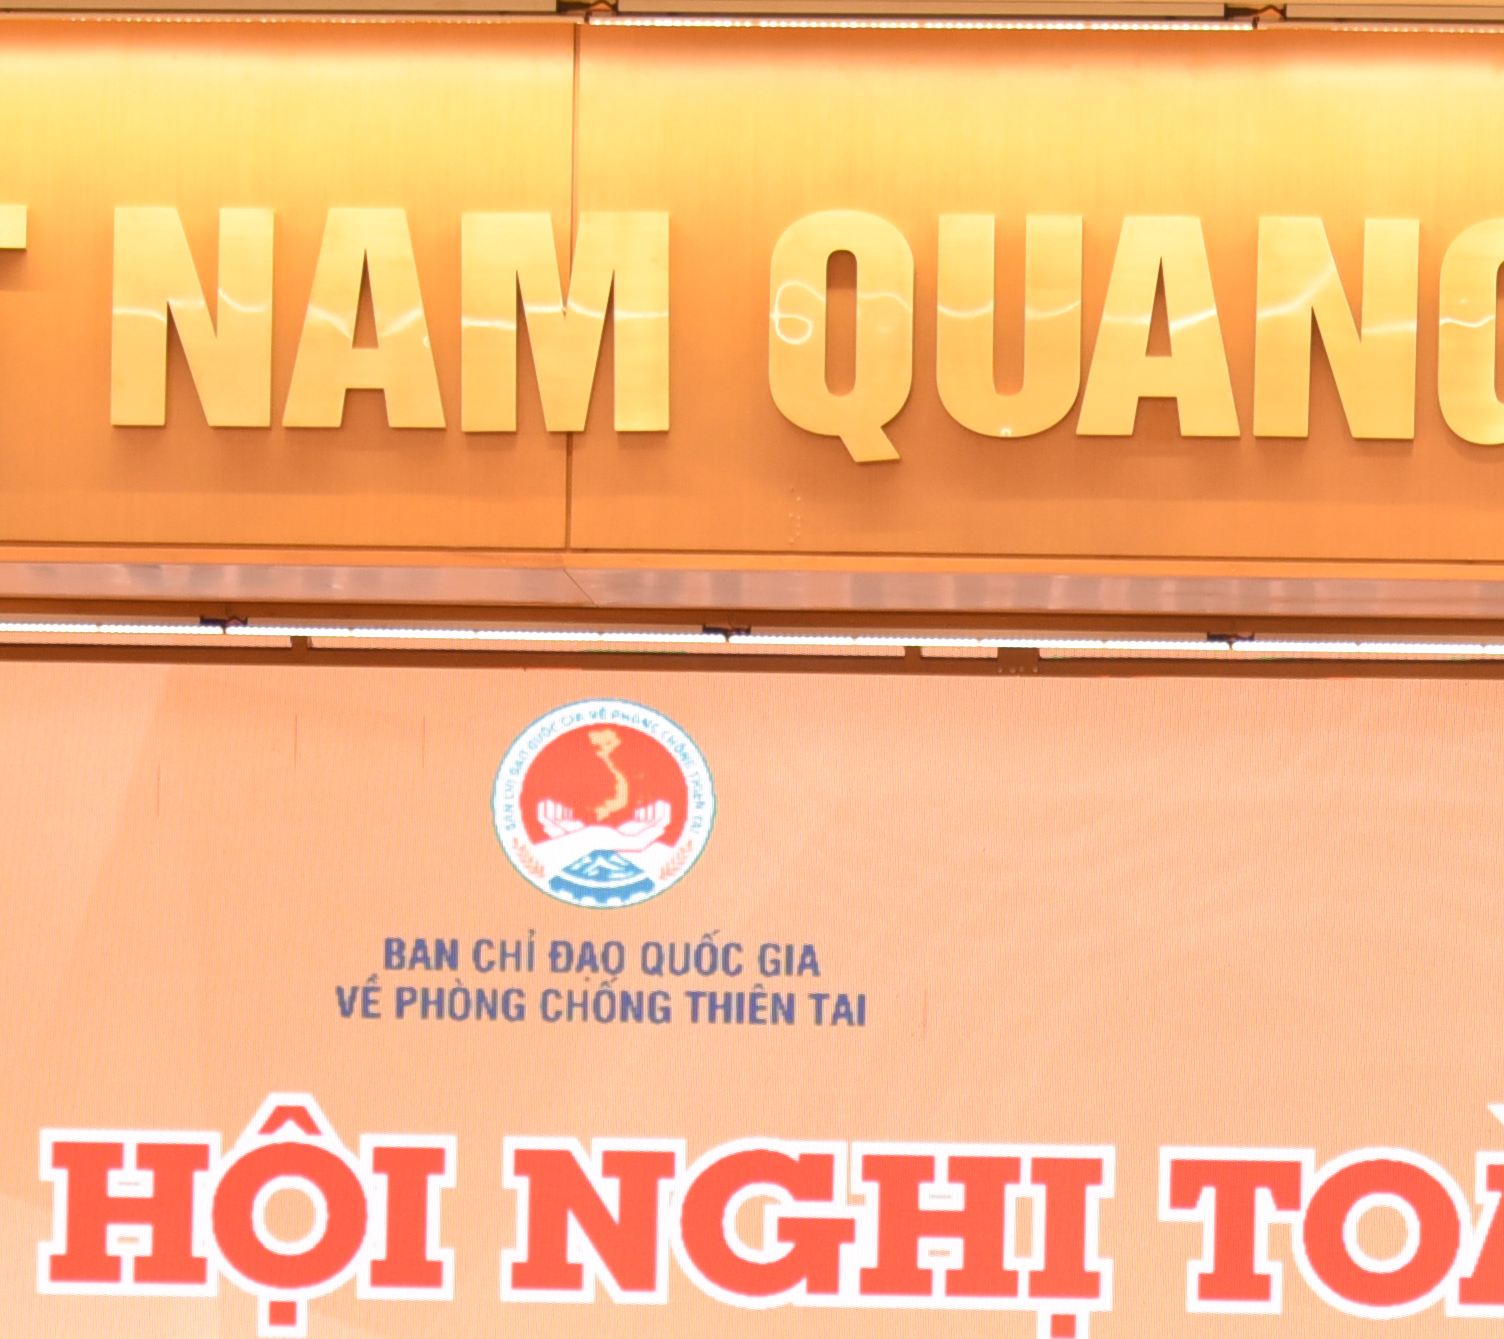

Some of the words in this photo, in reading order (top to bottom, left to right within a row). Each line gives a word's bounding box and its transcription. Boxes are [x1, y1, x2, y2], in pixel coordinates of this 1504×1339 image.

[110, 206, 671, 434] NAM
[336, 975, 380, 1019] VỀ
[396, 979, 525, 1022] PHÒNG
[541, 979, 671, 1024] CHỐNG
[685, 984, 795, 1025] THIÊN
[809, 993, 866, 1027] TAI
[384, 937, 459, 971] BAN
[473, 930, 535, 973] CHỈ
[549, 939, 625, 982] ĐẠO
[641, 930, 743, 977] QUỐC
[759, 943, 820, 977] GIA
[49, 1104, 446, 1326] HỘI
[511, 1148, 1103, 1338] NGHỊ
